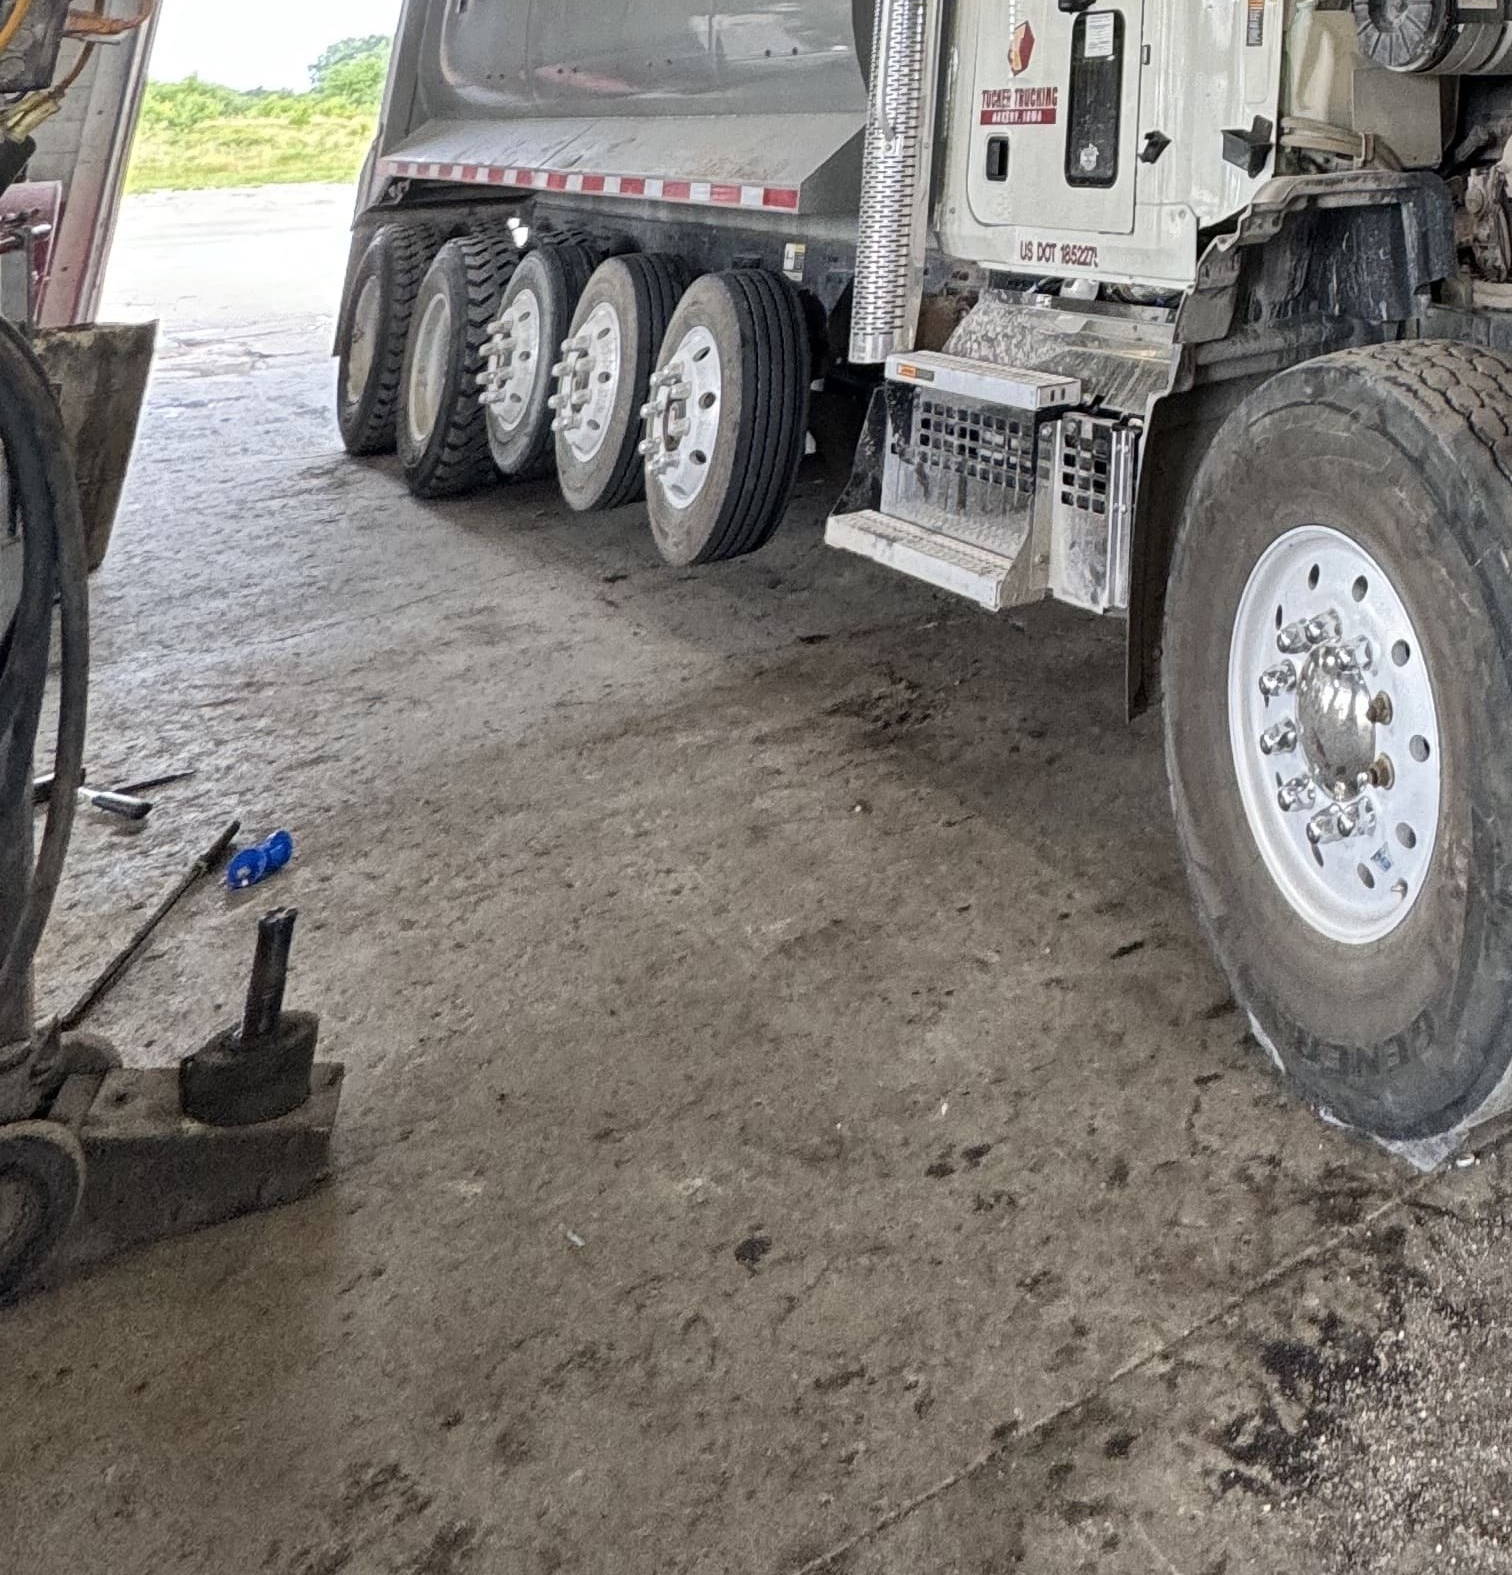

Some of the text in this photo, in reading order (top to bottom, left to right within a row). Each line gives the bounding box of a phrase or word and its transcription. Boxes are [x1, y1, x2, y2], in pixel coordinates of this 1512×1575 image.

[1014, 86, 1058, 108] TRUCKING
[1020, 240, 1033, 261] US
[1037, 241, 1056, 263] DOT
